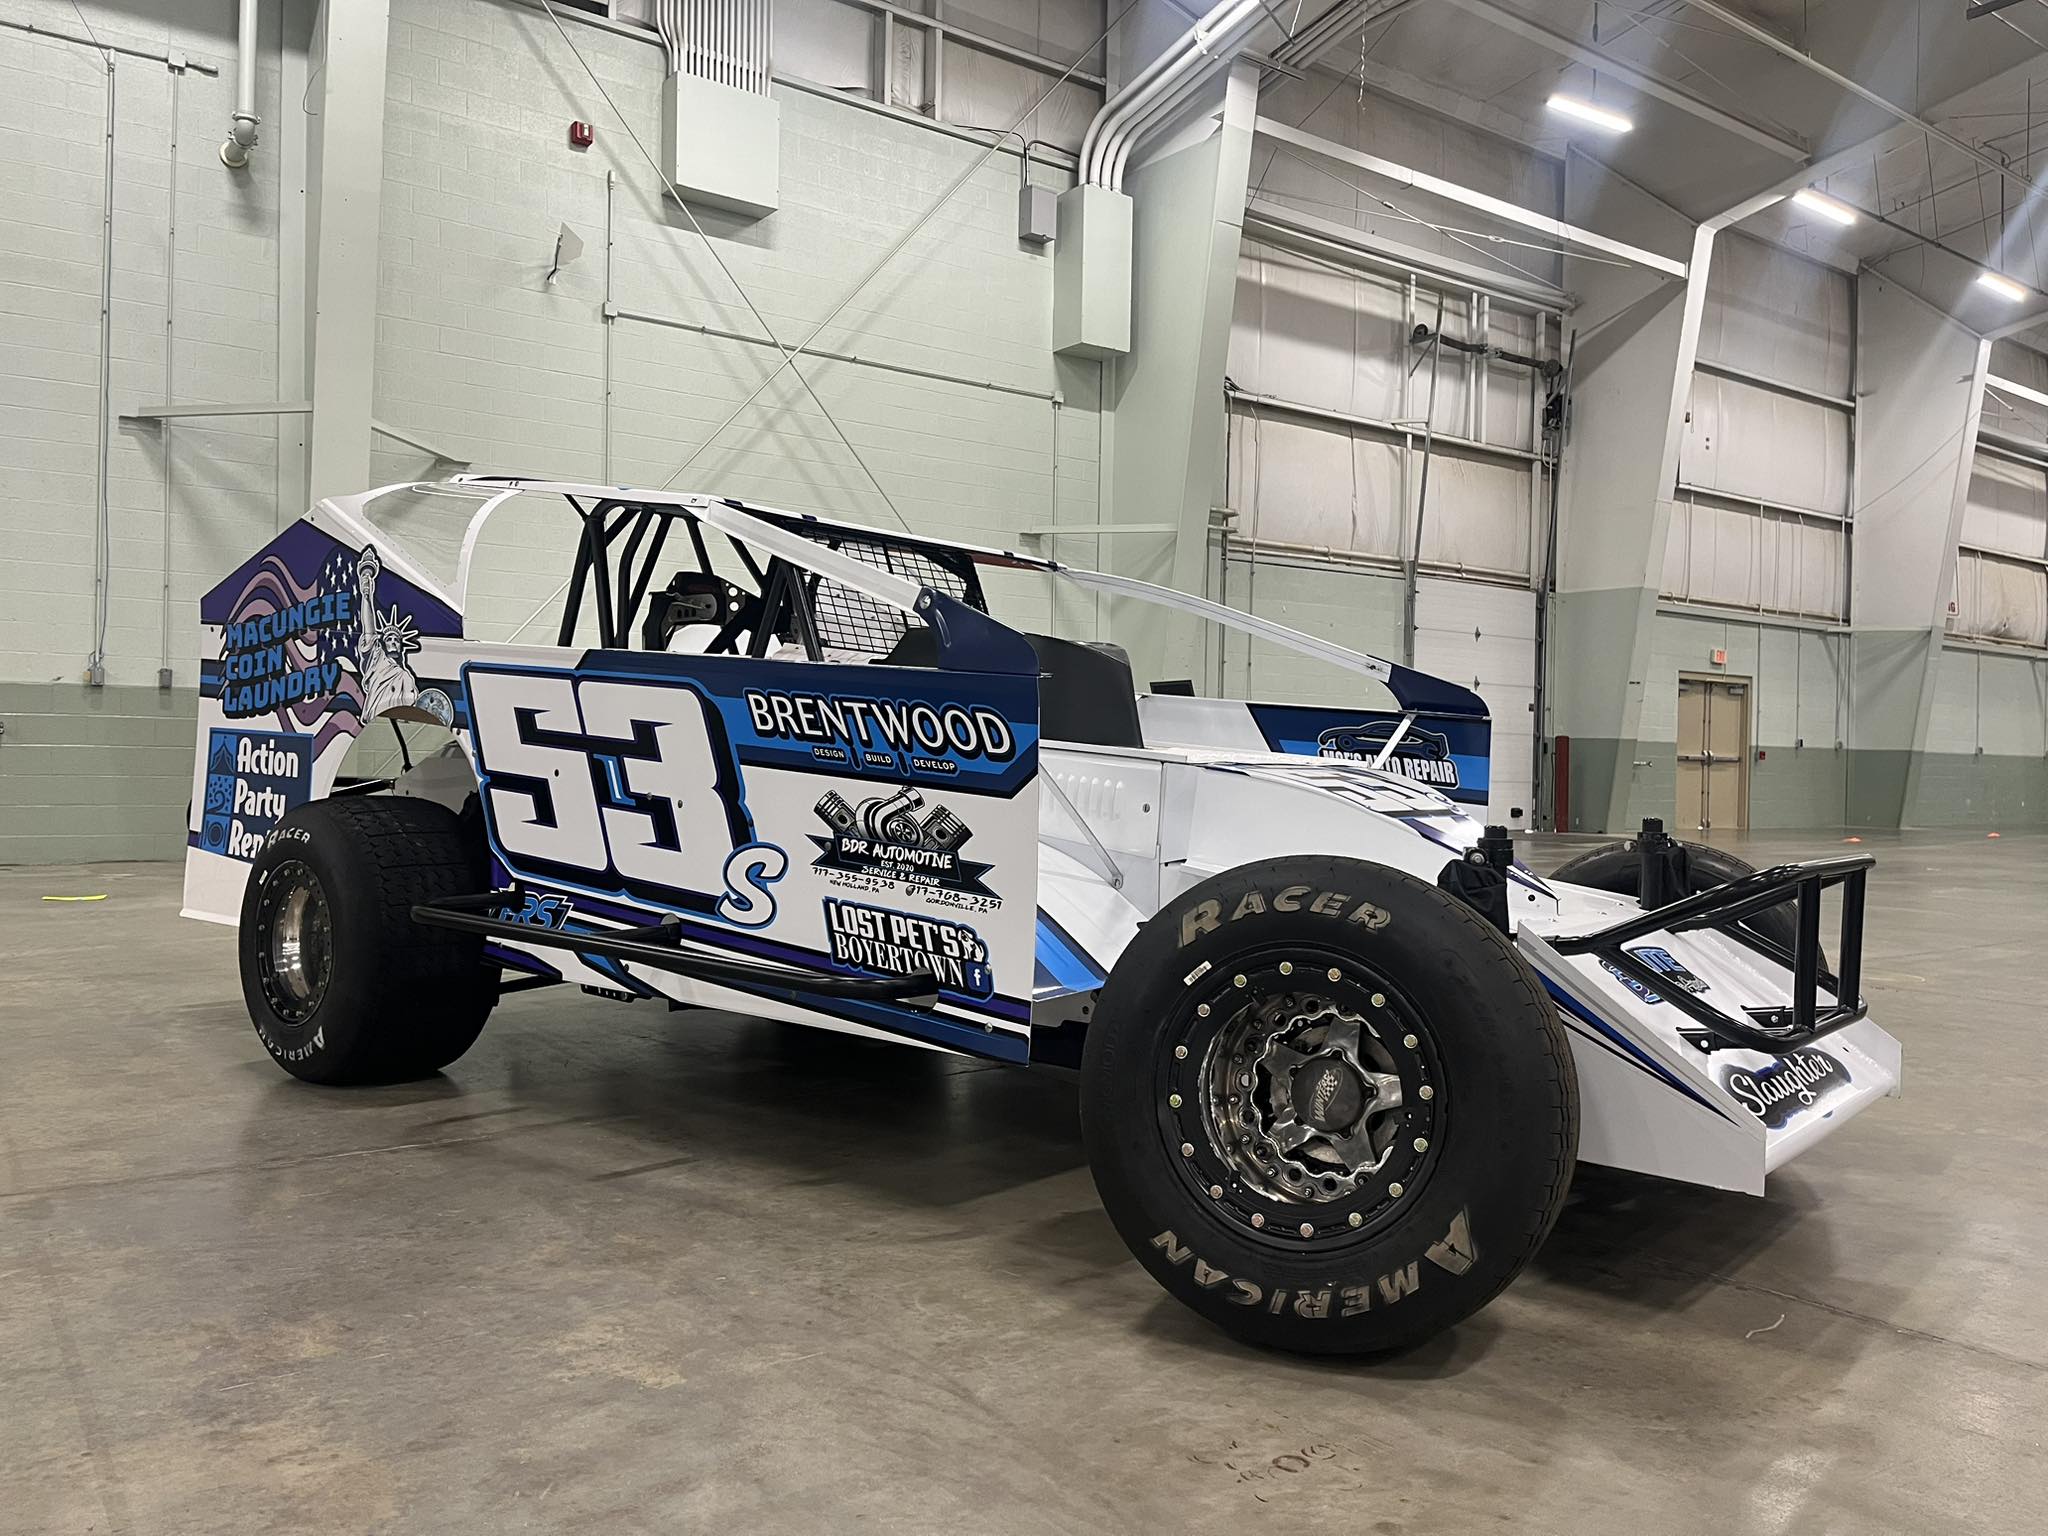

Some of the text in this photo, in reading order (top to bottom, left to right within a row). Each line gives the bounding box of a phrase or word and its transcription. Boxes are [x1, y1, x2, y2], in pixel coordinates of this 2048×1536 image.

[226, 592, 351, 649] MACUNGIE
[225, 644, 284, 681] COIN
[223, 662, 338, 712] LAUNDRY
[747, 693, 1010, 754] BRENTWOOD
[237, 736, 299, 778] Action
[814, 748, 956, 771] DESIGN BUILD DEVELOP
[1402, 757, 1456, 784] REPAIR
[233, 778, 287, 825] Party
[468, 671, 735, 898] 53
[268, 827, 311, 849] RACER
[841, 838, 953, 869] BDR AUTOMOTIVE
[812, 866, 895, 889] 717-355-9538
[861, 865, 941, 887] SERVICE & REPAIR
[880, 859, 914, 872] EST. 2020
[829, 902, 961, 958] LOST PET'S
[1177, 885, 1393, 949] RACER
[834, 931, 965, 988] BOYERTOWN
[1729, 1052, 1834, 1117] Slaughter
[1151, 1204, 1479, 1319] AMERICAN
